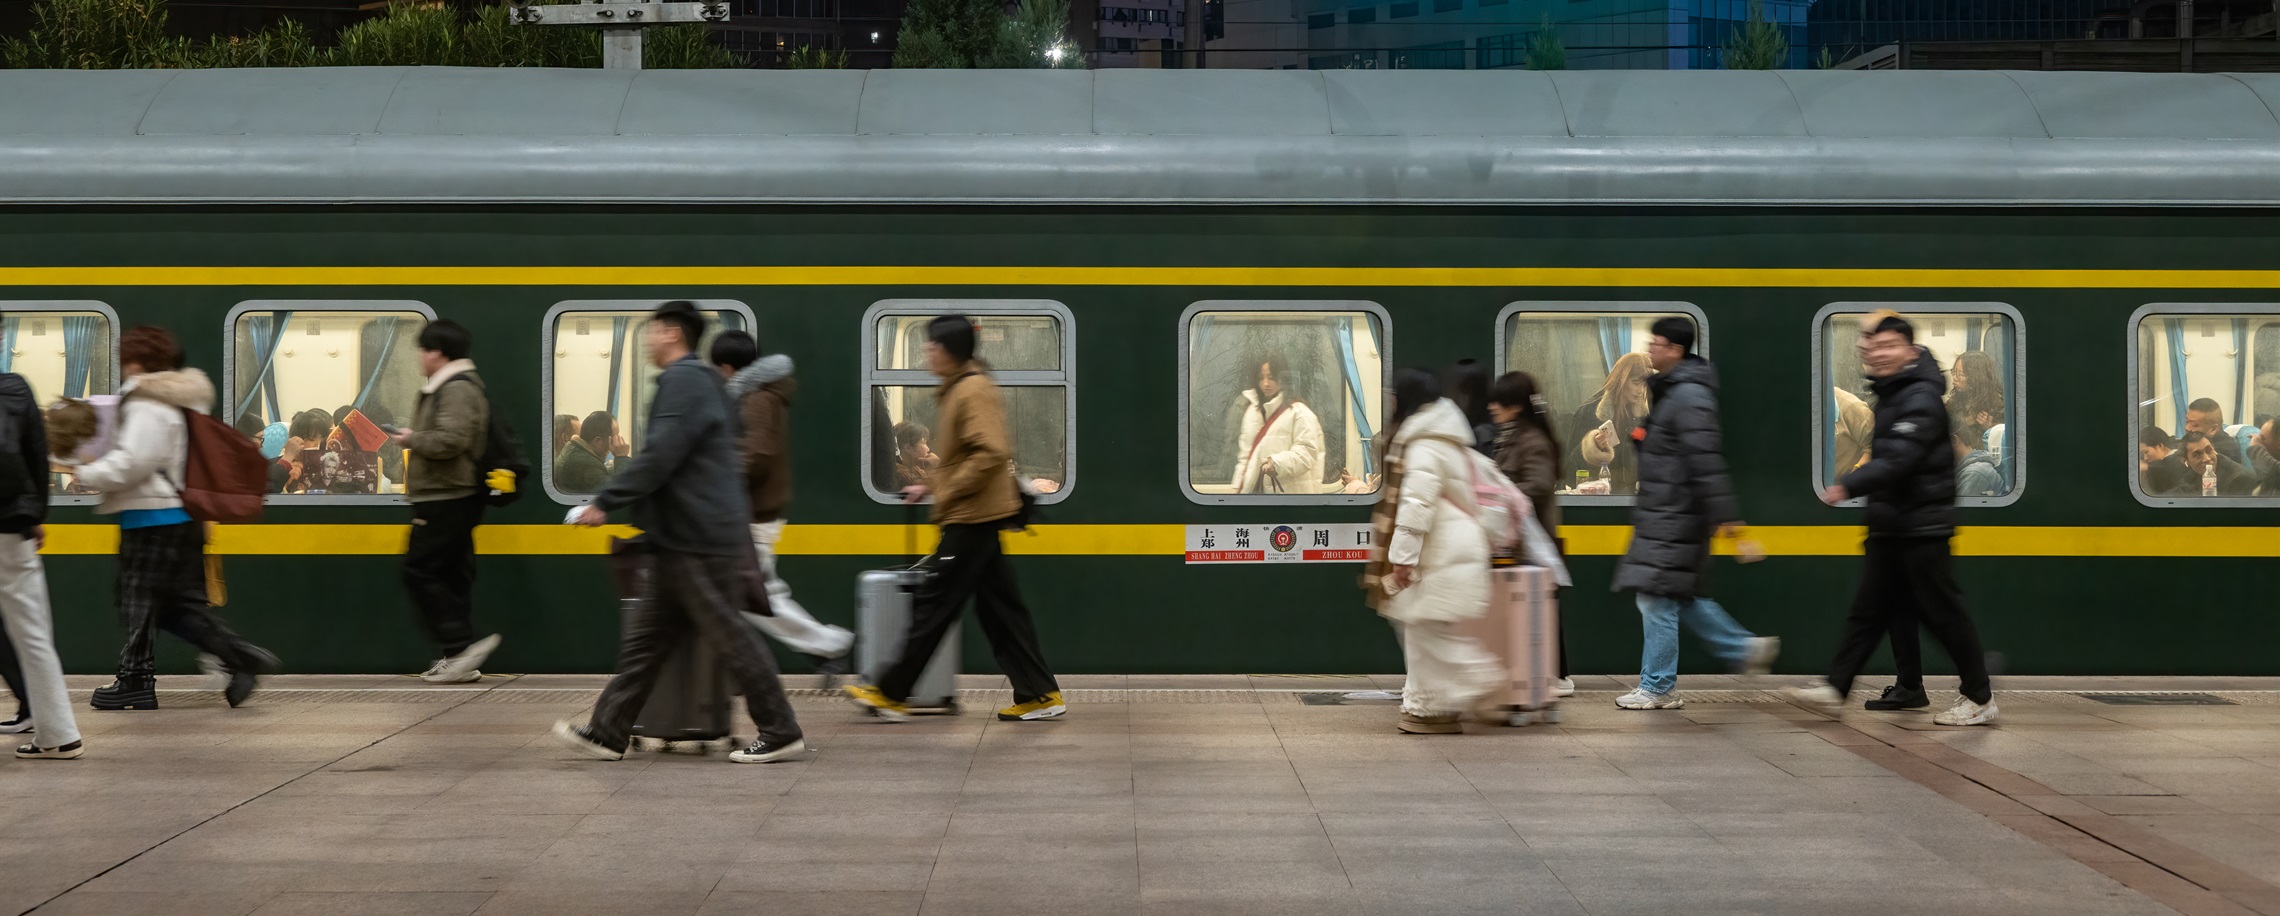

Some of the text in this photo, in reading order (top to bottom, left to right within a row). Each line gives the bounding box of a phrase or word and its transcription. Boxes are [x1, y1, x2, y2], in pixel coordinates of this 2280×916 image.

[1313, 529, 1370, 547] 周口
[1244, 551, 1259, 559] ZHOU
[1322, 551, 1363, 559] ZHOU KOU
